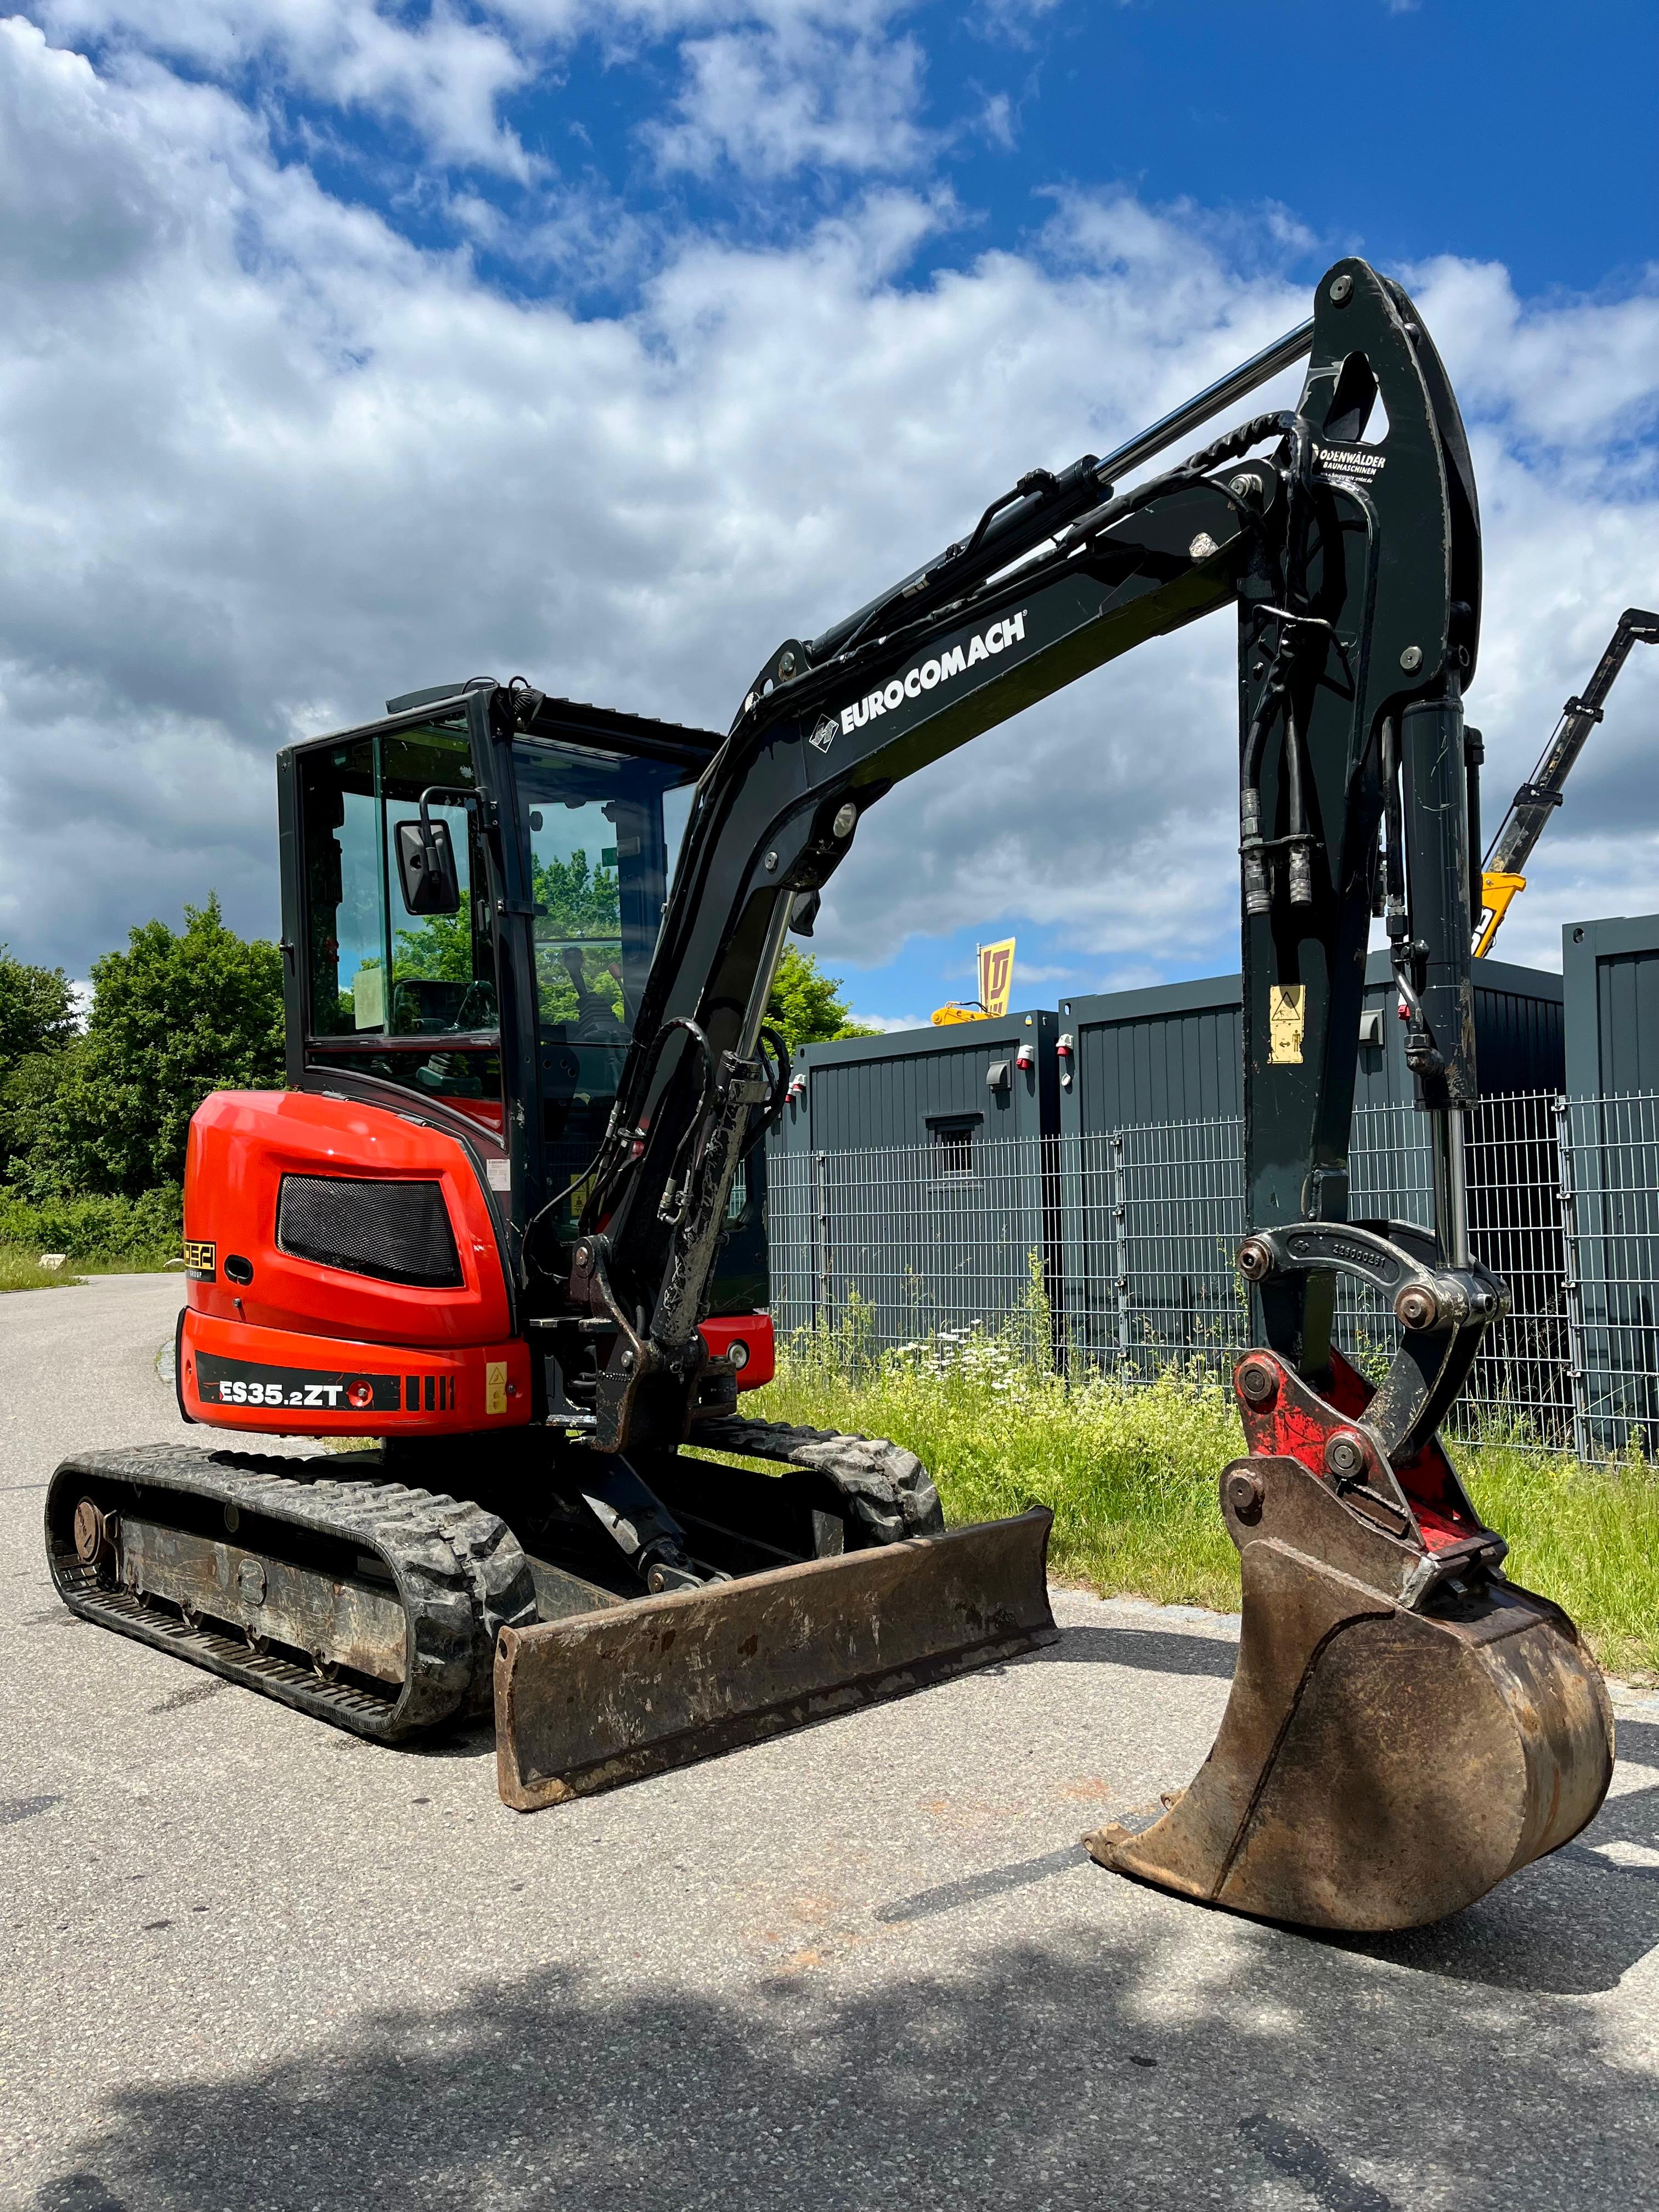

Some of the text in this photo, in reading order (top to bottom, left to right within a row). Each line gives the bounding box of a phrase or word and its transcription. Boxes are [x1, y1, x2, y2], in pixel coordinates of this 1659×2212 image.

[1320, 449, 1386, 469] ODENWÄLDER
[1323, 461, 1377, 476] BAUMASCHINEN
[189, 1270, 202, 1278] GROUP
[219, 1381, 343, 1406] ES35.2ZT
